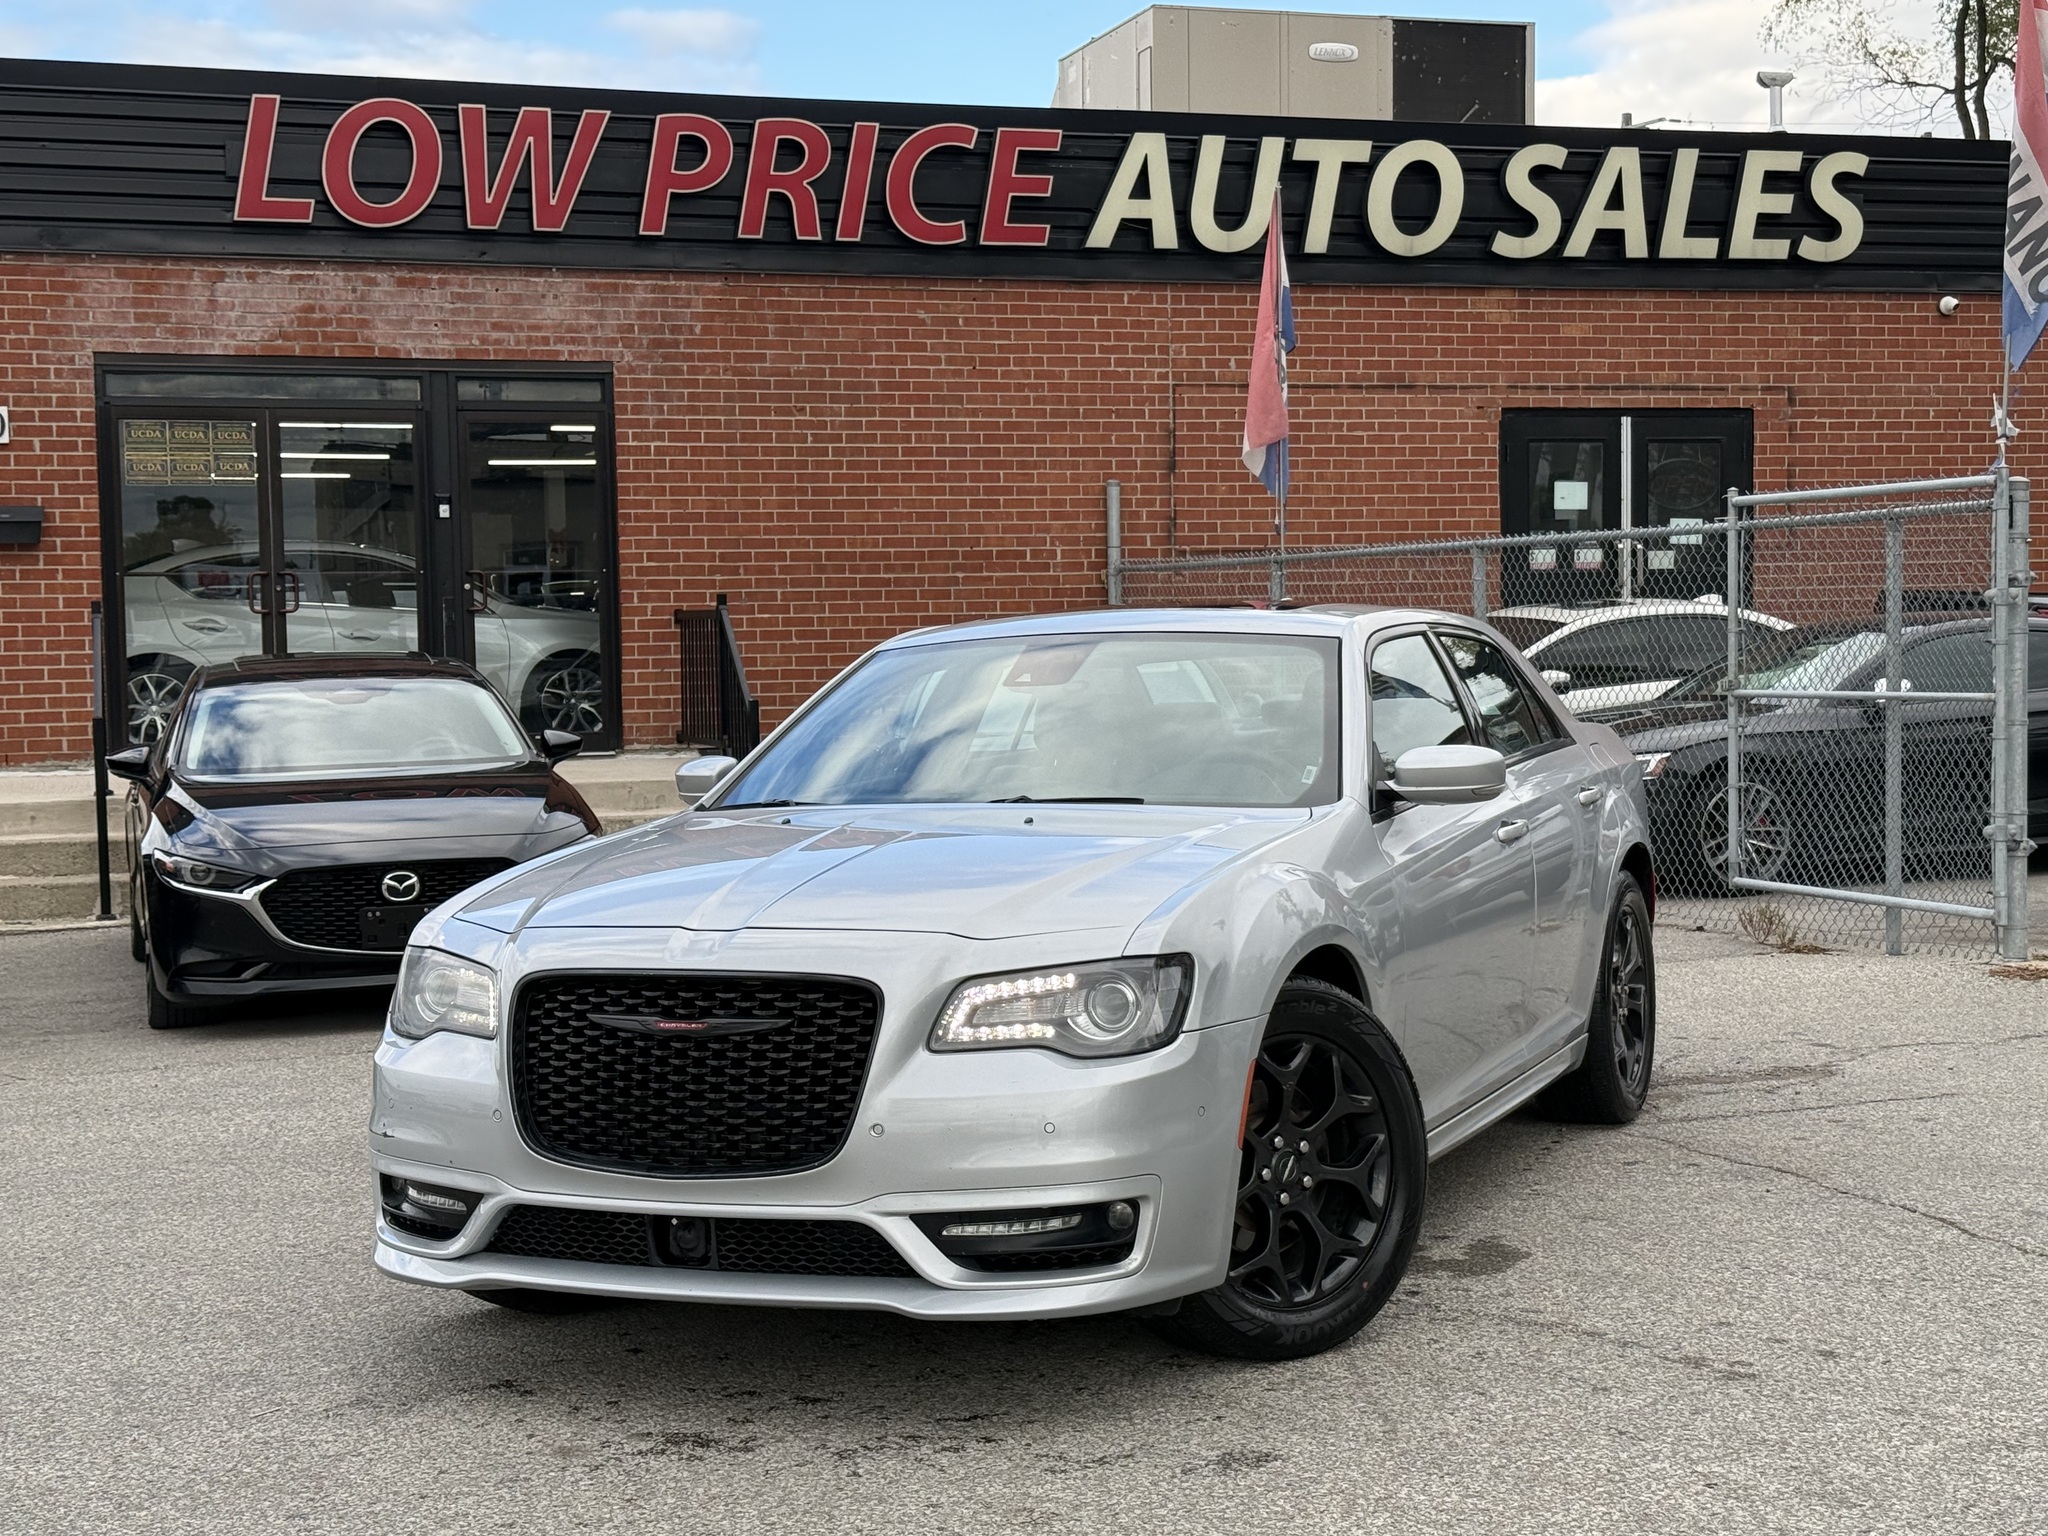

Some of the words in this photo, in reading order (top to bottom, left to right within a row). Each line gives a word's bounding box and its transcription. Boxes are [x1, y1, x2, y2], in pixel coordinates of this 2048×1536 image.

[1313, 46, 1347, 57] LENNOX
[233, 94, 611, 232] LOW
[637, 112, 1063, 248] PRICE
[1085, 132, 1464, 257] AUTO
[1490, 143, 1870, 263] SALES
[130, 429, 162, 438] UCDA
[174, 430, 205, 440] UCDA
[217, 431, 248, 440] UCDA
[132, 463, 162, 471] UCDA
[175, 463, 205, 471] UCDA
[219, 462, 250, 471] UCDA
